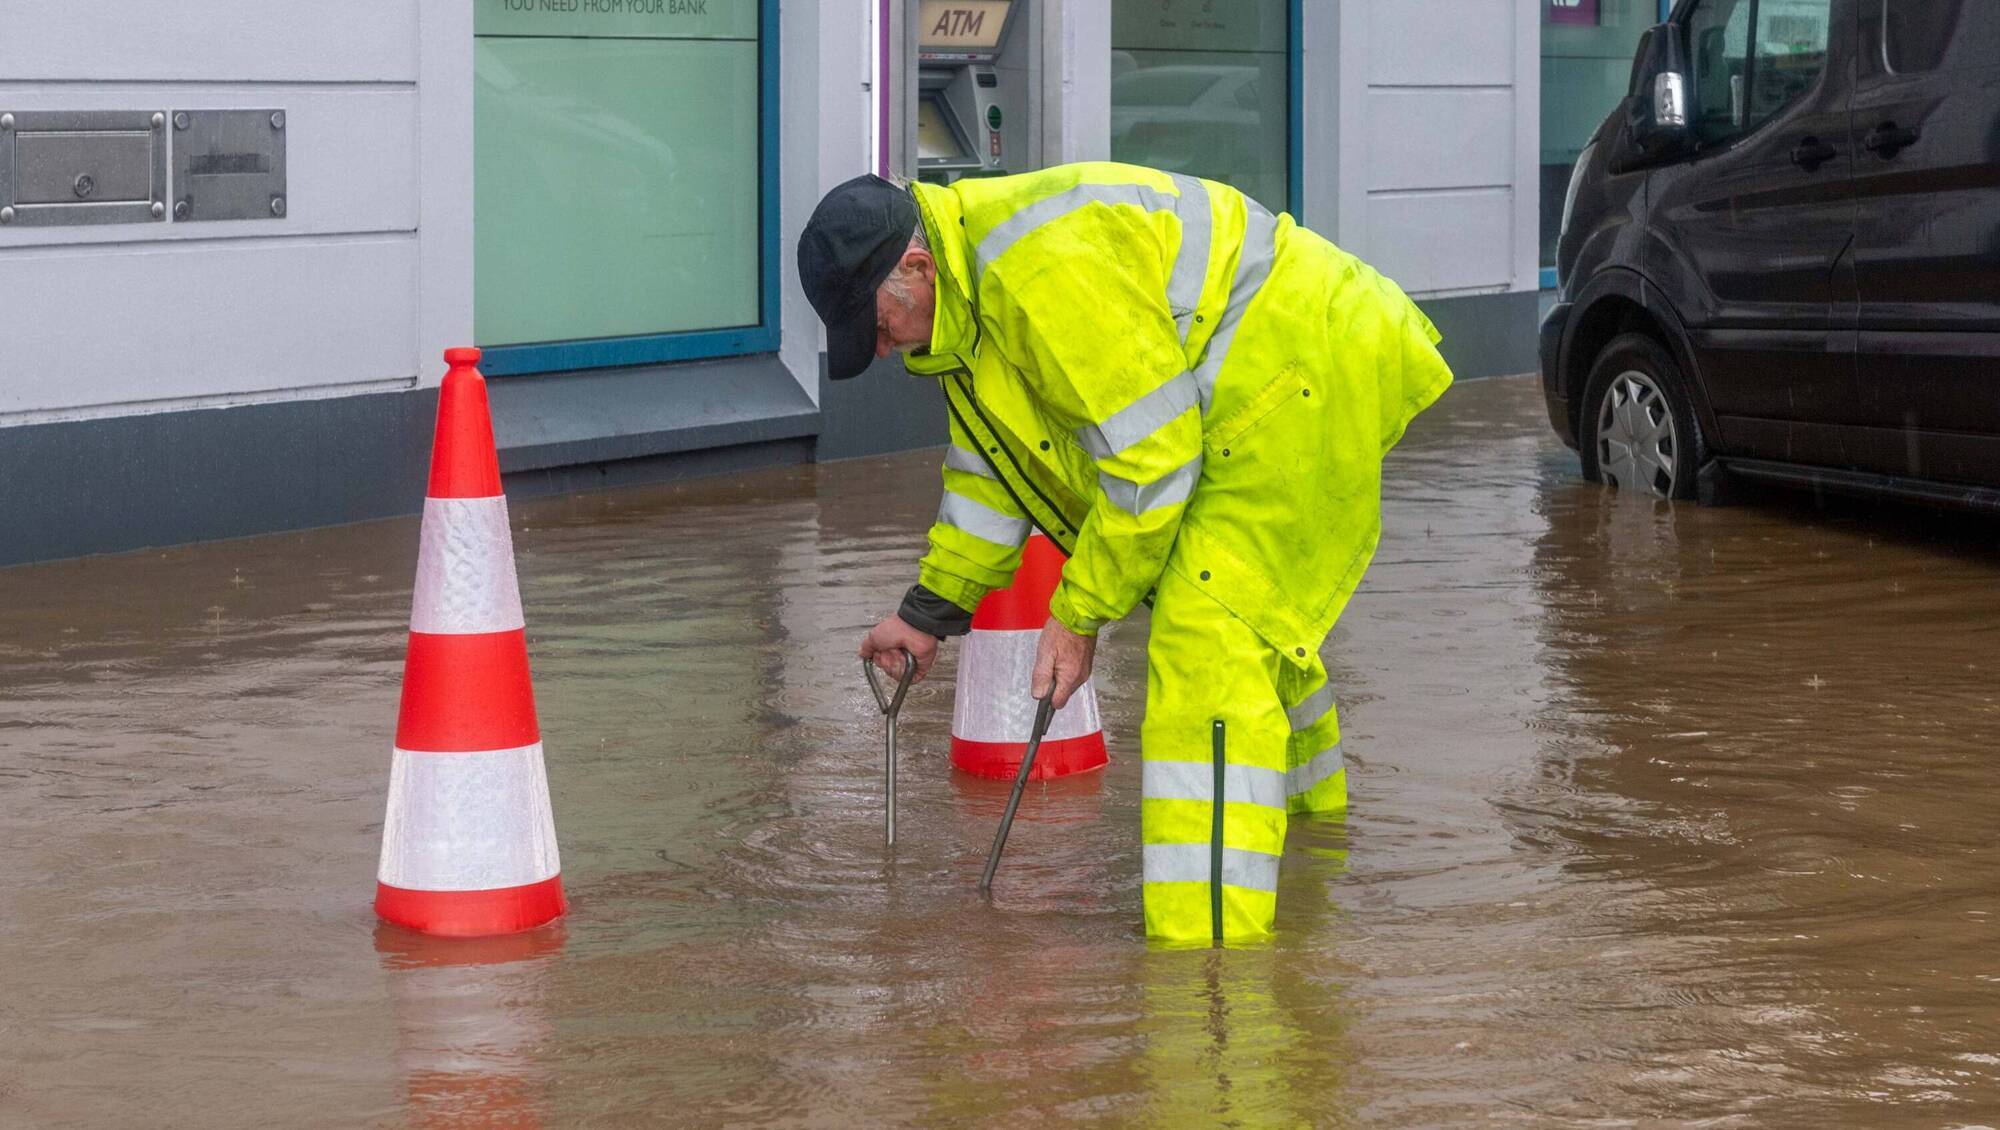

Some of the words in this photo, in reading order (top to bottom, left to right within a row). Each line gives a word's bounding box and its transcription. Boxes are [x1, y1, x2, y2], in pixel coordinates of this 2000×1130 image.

[503, 0, 534, 12] YOU
[540, 0, 578, 13] NEED
[583, 0, 622, 14] FROM
[625, 0, 664, 15] YOUR
[669, 0, 707, 16] BANK
[931, 9, 985, 36] ATM
